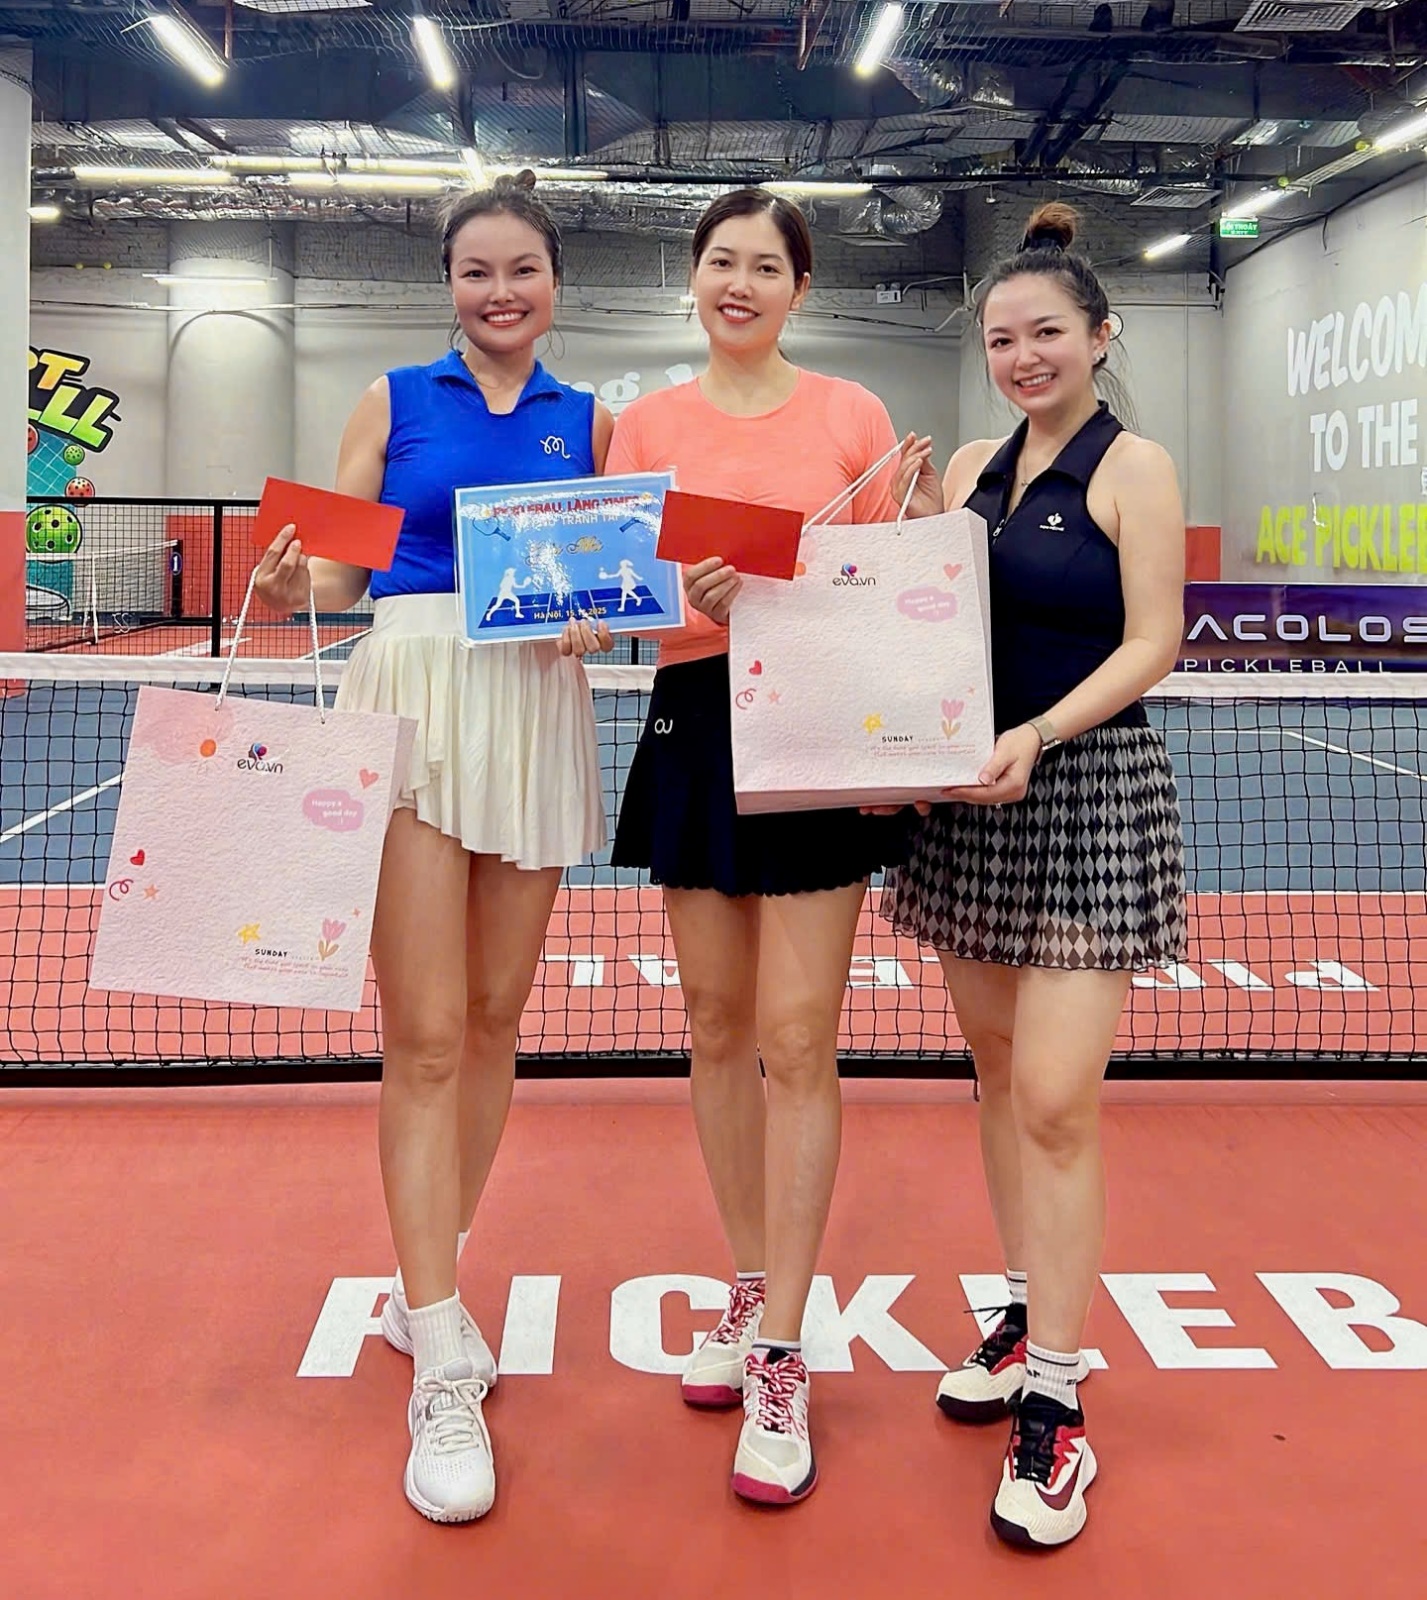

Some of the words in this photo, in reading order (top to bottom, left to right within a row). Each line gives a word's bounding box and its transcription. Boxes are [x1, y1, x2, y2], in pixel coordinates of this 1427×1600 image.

[1310, 410, 1350, 472] TO
[1357, 398, 1419, 469] THE
[1257, 504, 1308, 567] ACE
[172, 555, 179, 572] 1
[832, 575, 876, 586] eva.vn
[1183, 658, 1392, 674] PICKLEBALL
[882, 735, 914, 743] SUNDAY
[237, 758, 284, 774] eva.vn
[255, 948, 289, 958] SUNDAY
